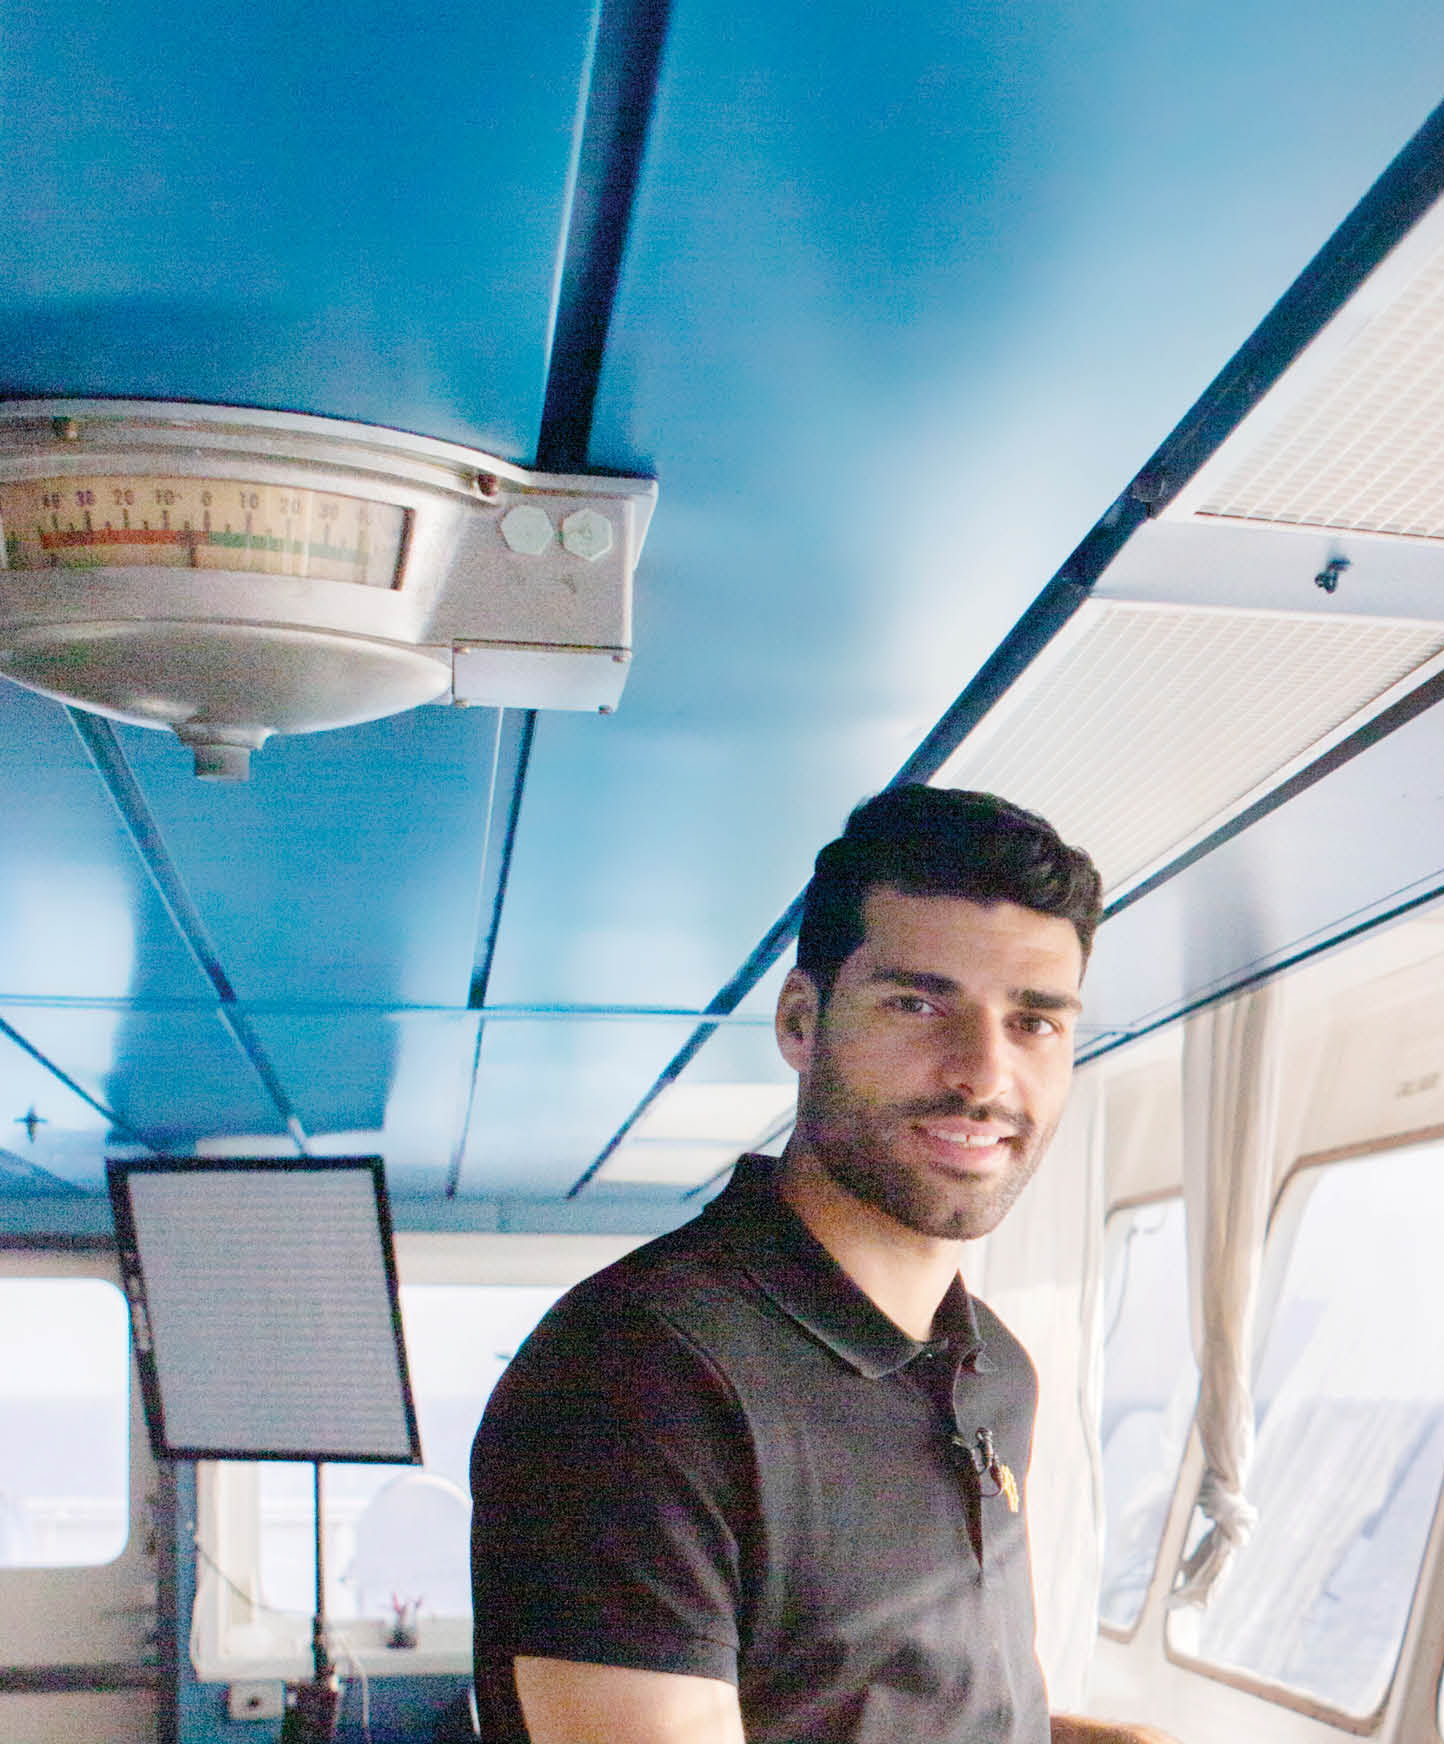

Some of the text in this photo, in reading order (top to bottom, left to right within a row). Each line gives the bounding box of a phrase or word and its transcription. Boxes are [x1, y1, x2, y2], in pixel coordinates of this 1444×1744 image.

[154, 488, 175, 506] 10
[201, 489, 213, 507] 0
[240, 490, 259, 510] 10
